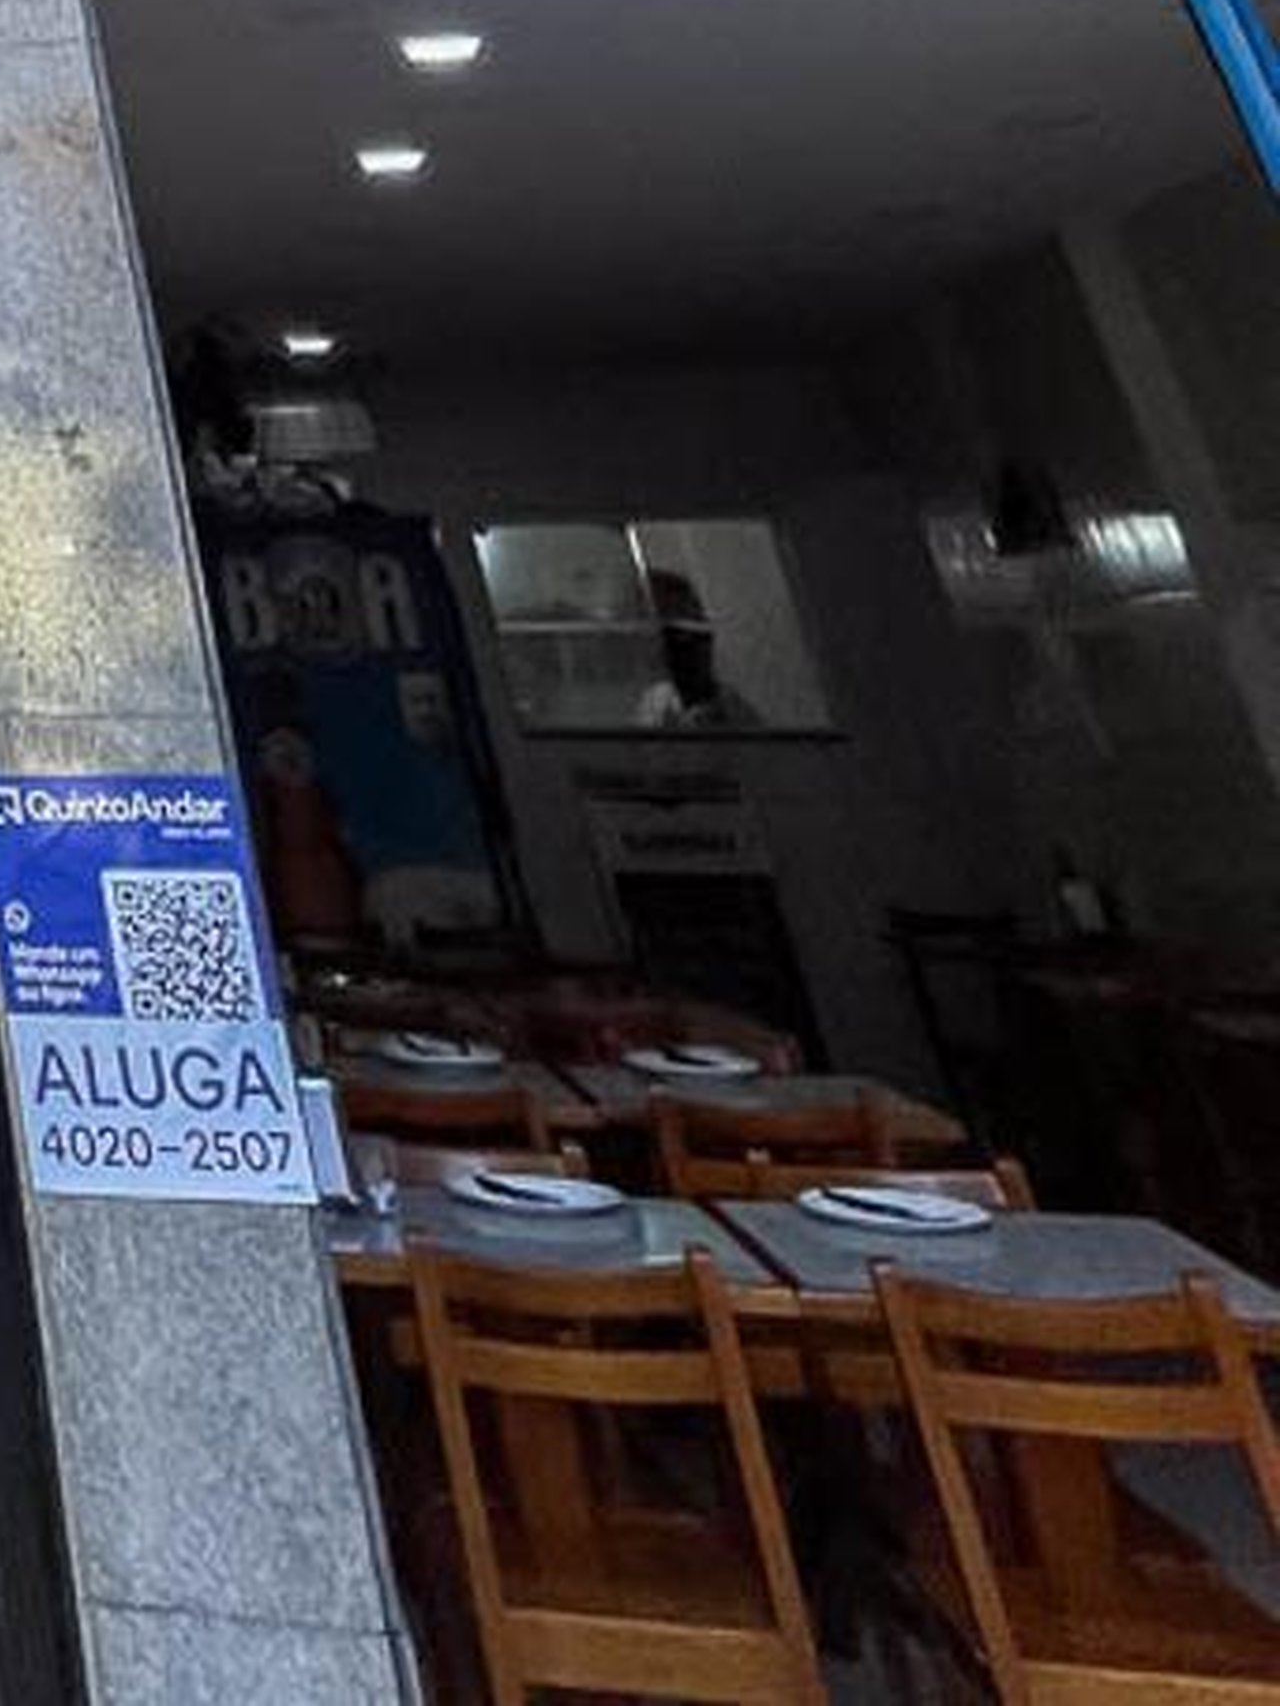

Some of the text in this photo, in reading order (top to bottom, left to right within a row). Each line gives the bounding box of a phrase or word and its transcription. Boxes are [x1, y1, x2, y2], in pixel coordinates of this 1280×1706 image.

[25, 790, 230, 824] QuintoAndar
[35, 1045, 284, 1113] ALUGA
[42, 1126, 292, 1172] 4020-2507
